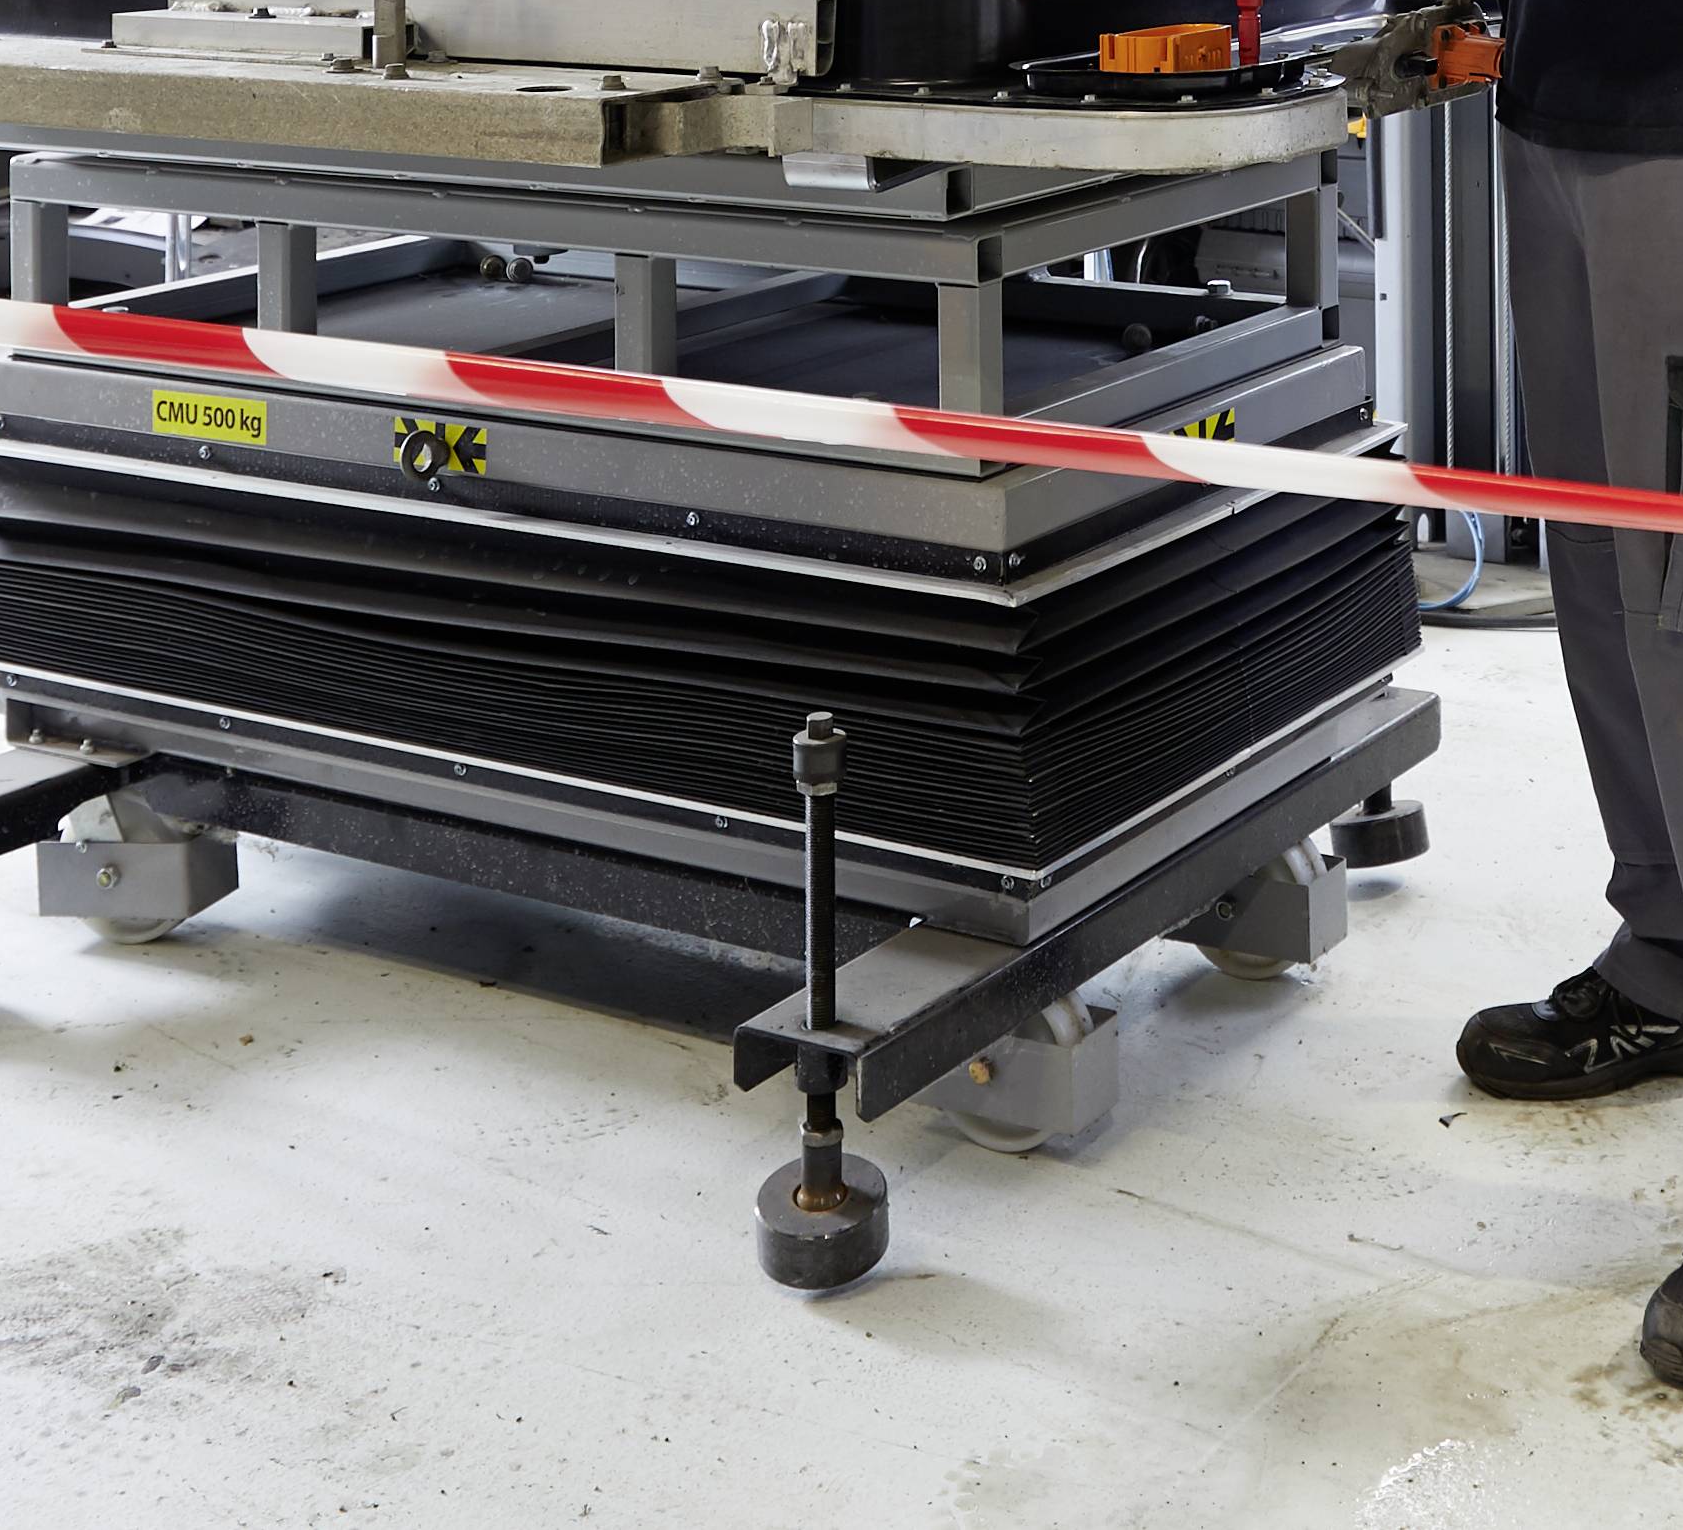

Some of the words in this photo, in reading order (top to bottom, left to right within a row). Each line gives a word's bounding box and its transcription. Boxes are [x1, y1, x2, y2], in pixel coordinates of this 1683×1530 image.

[157, 400, 198, 425] CMU
[203, 405, 236, 429] 500
[240, 408, 262, 439] kg
